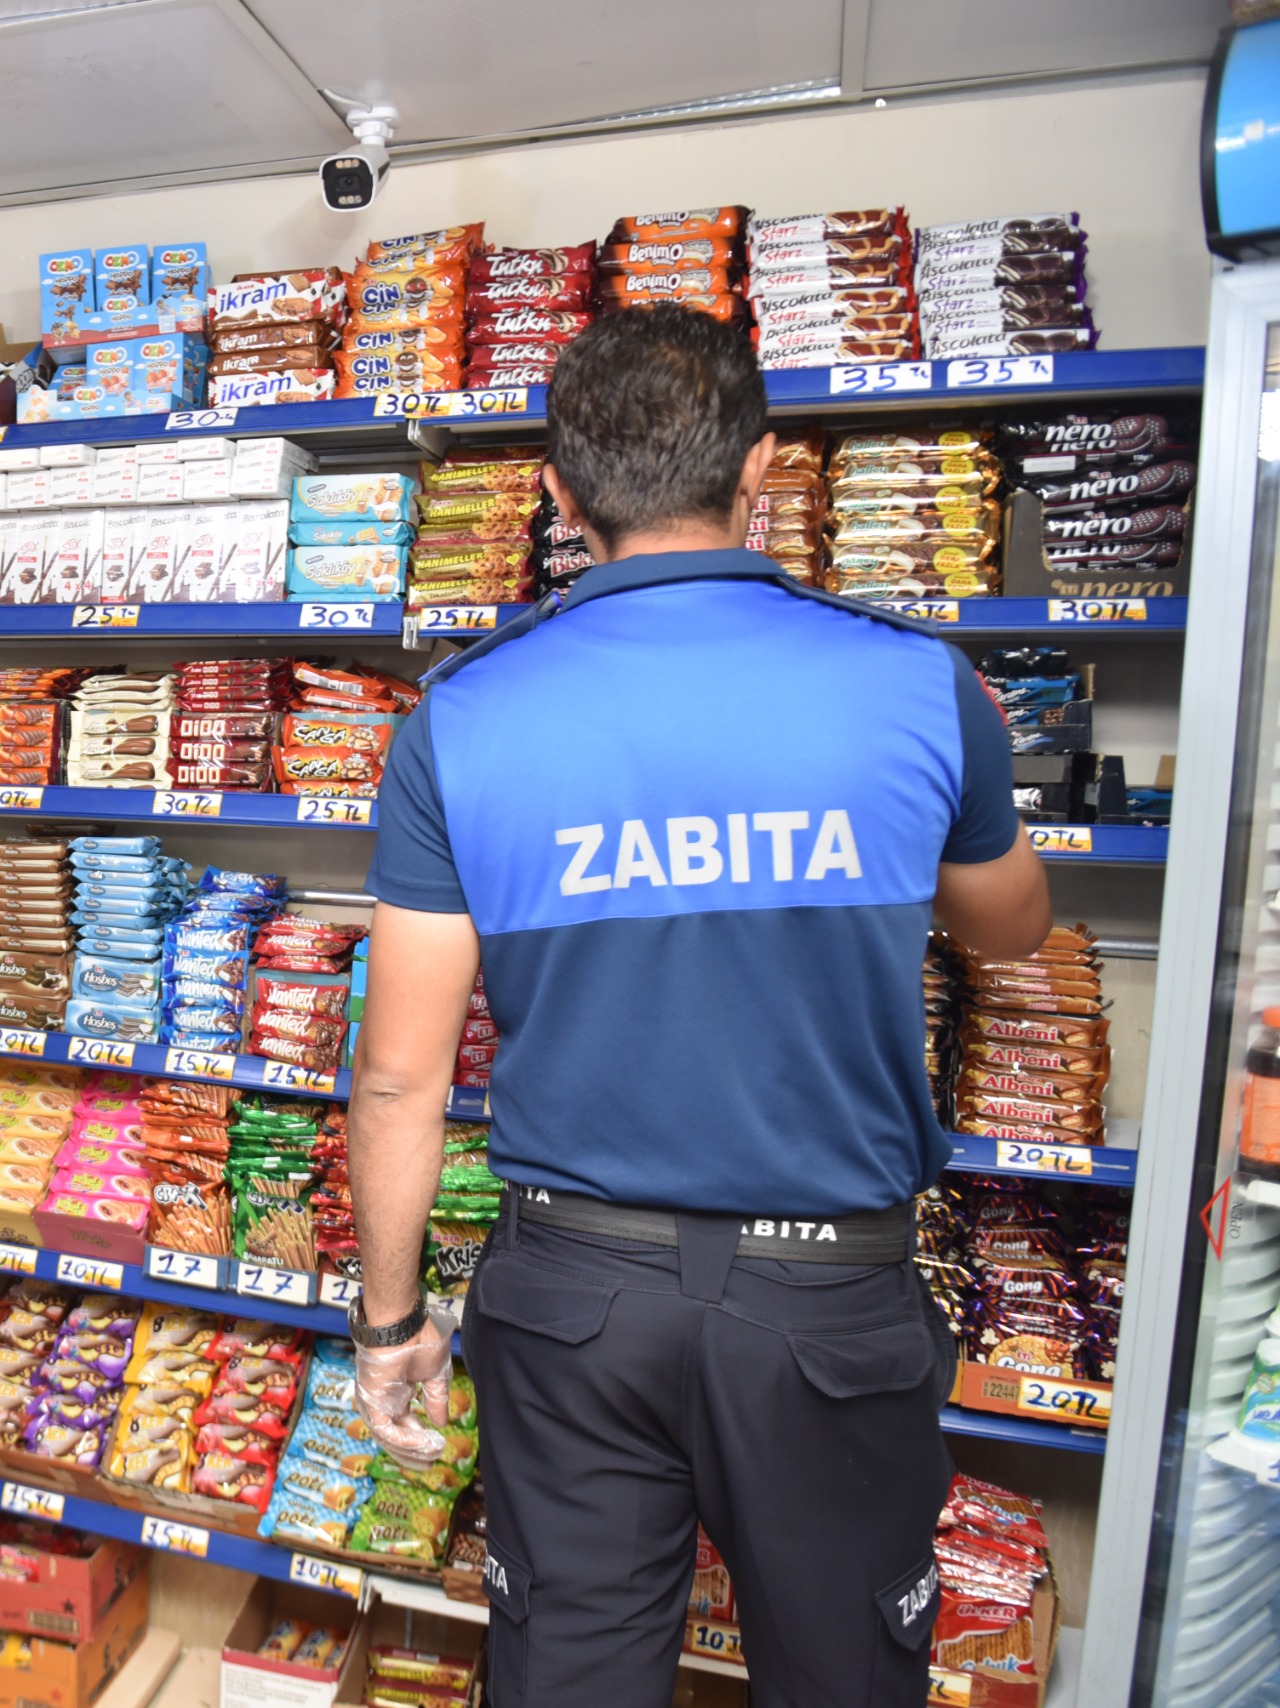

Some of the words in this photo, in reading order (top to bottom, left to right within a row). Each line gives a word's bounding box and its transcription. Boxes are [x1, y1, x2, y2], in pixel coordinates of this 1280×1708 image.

[219, 281, 288, 313] ikram
[768, 310, 807, 325] Starz
[222, 355, 260, 371] ikram
[958, 358, 1014, 386] 35
[220, 374, 292, 402] ikram
[839, 365, 900, 394] 35
[1044, 424, 1113, 442] nero
[1070, 477, 1139, 500] nero
[429, 498, 496, 518] HANIMELLER
[851, 521, 890, 535] halley
[1062, 515, 1132, 538] nero
[309, 605, 348, 627] 30
[294, 724, 347, 745] CANGA
[288, 758, 339, 779] CANGA
[555, 809, 863, 897] ZABITA
[984, 1020, 1058, 1042] Albeni
[988, 1046, 1062, 1070] Albeni
[980, 1073, 1055, 1097] Albeni
[980, 1100, 1054, 1124] Albeni
[157, 1252, 202, 1278] 17
[244, 1268, 294, 1296] 17
[1003, 1280, 1043, 1296] Gong
[957, 1603, 1017, 1620] ÜLKER
